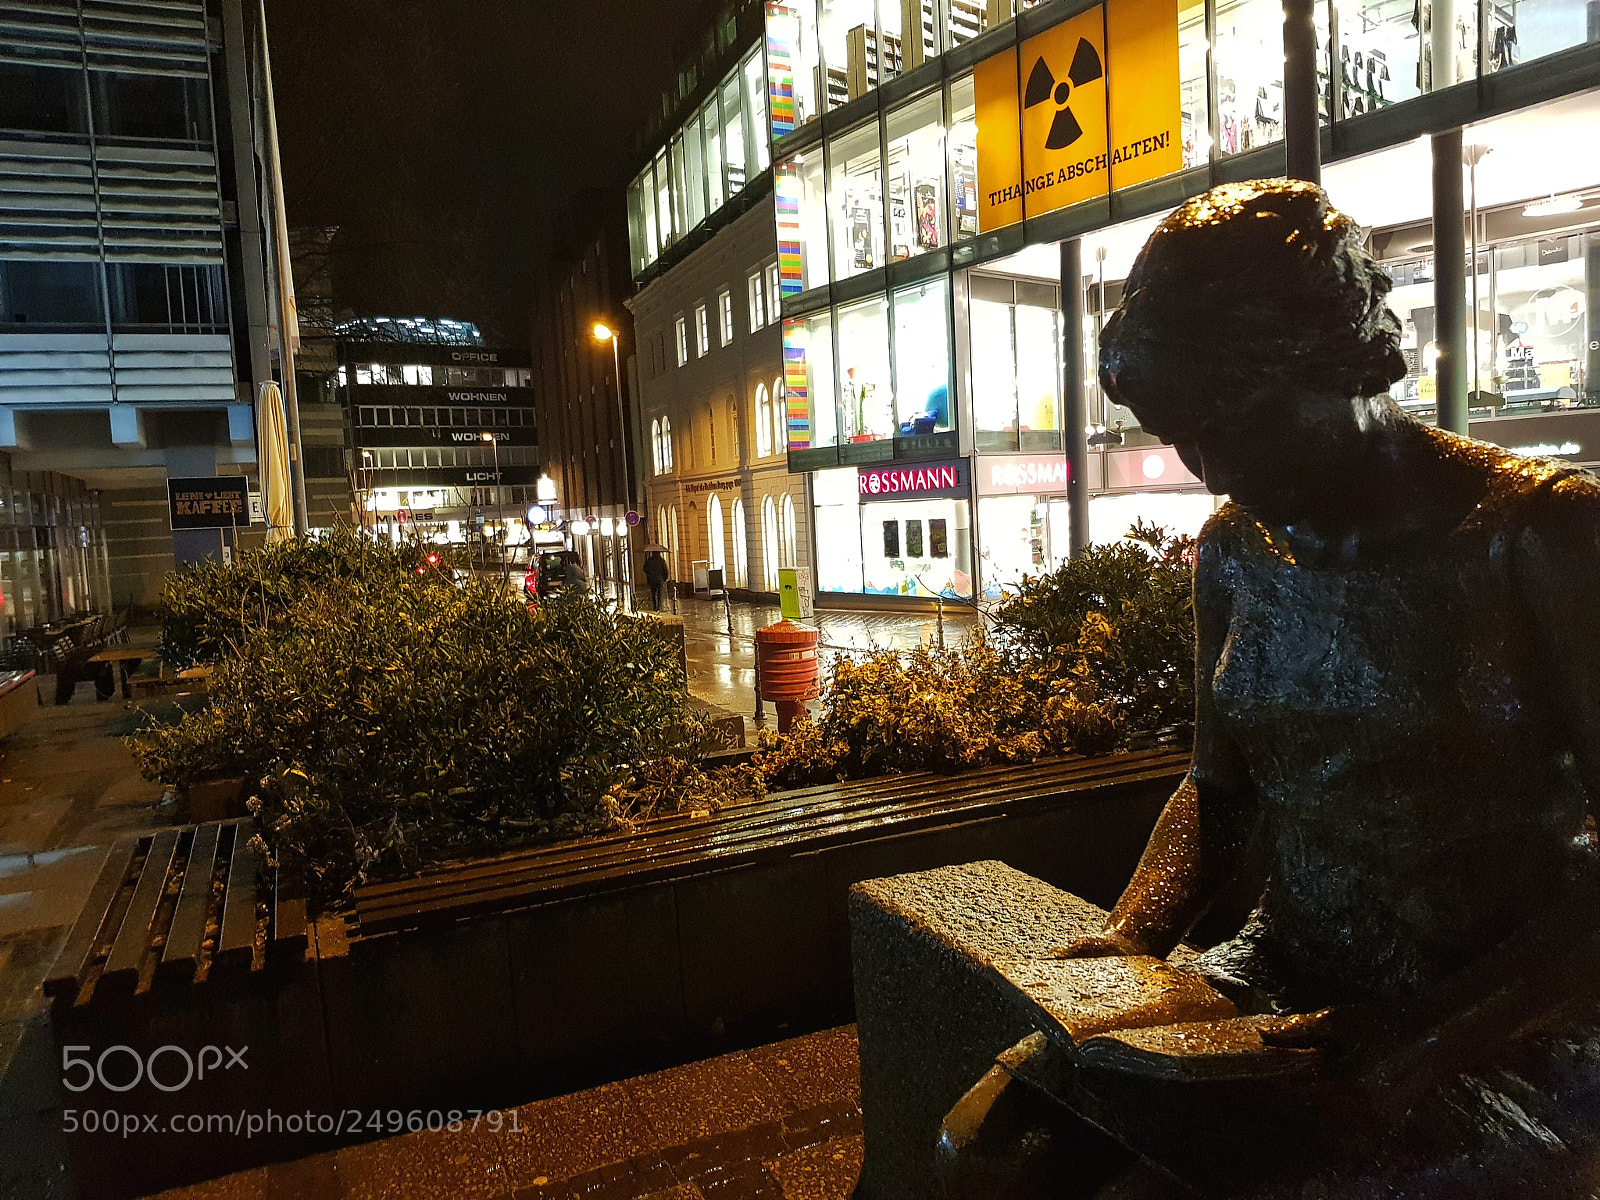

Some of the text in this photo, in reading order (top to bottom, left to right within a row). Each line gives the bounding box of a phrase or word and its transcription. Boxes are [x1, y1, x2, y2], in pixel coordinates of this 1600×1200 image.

[988, 170, 1055, 207] TIHANGE
[1057, 131, 1171, 184] ABSCHALTEN!
[451, 353, 498, 362] OFFICE
[448, 392, 507, 402] WOHNEN
[451, 432, 510, 441] WOHEN
[466, 472, 503, 481] LICHT
[859, 465, 956, 494] ROSSMANN
